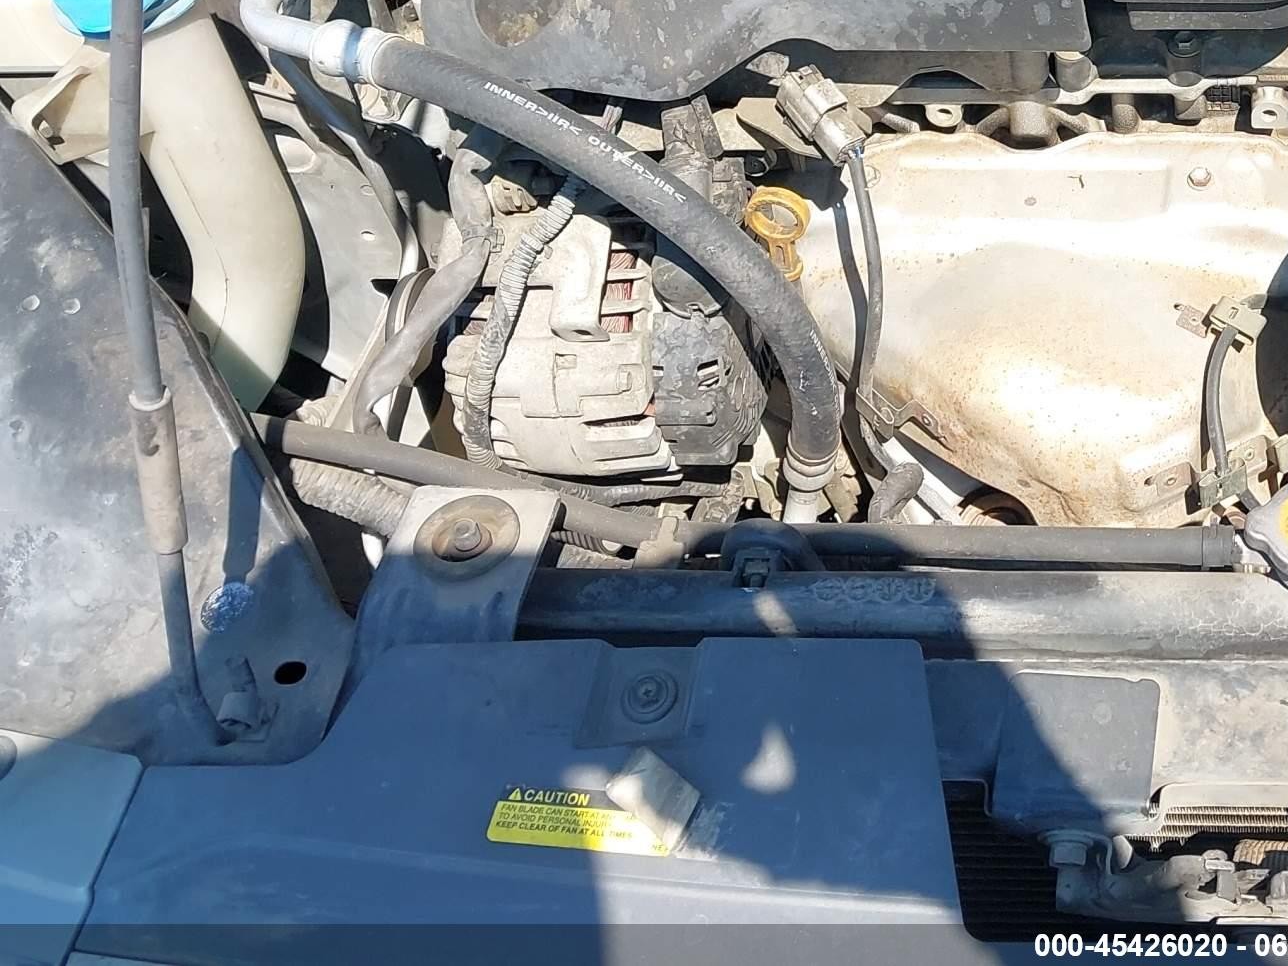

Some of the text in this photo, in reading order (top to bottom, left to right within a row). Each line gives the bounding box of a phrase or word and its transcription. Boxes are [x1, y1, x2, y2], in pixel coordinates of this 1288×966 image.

[524, 789, 590, 806] CAUTION
[518, 806, 545, 814] BLADE
[546, 807, 562, 816] CAN
[563, 809, 589, 818] START
[510, 813, 536, 822] AVOID
[537, 816, 580, 826] PERSONAL
[518, 822, 546, 832] CLEAR
[561, 826, 578, 834] FAN
[590, 828, 604, 837] ALL
